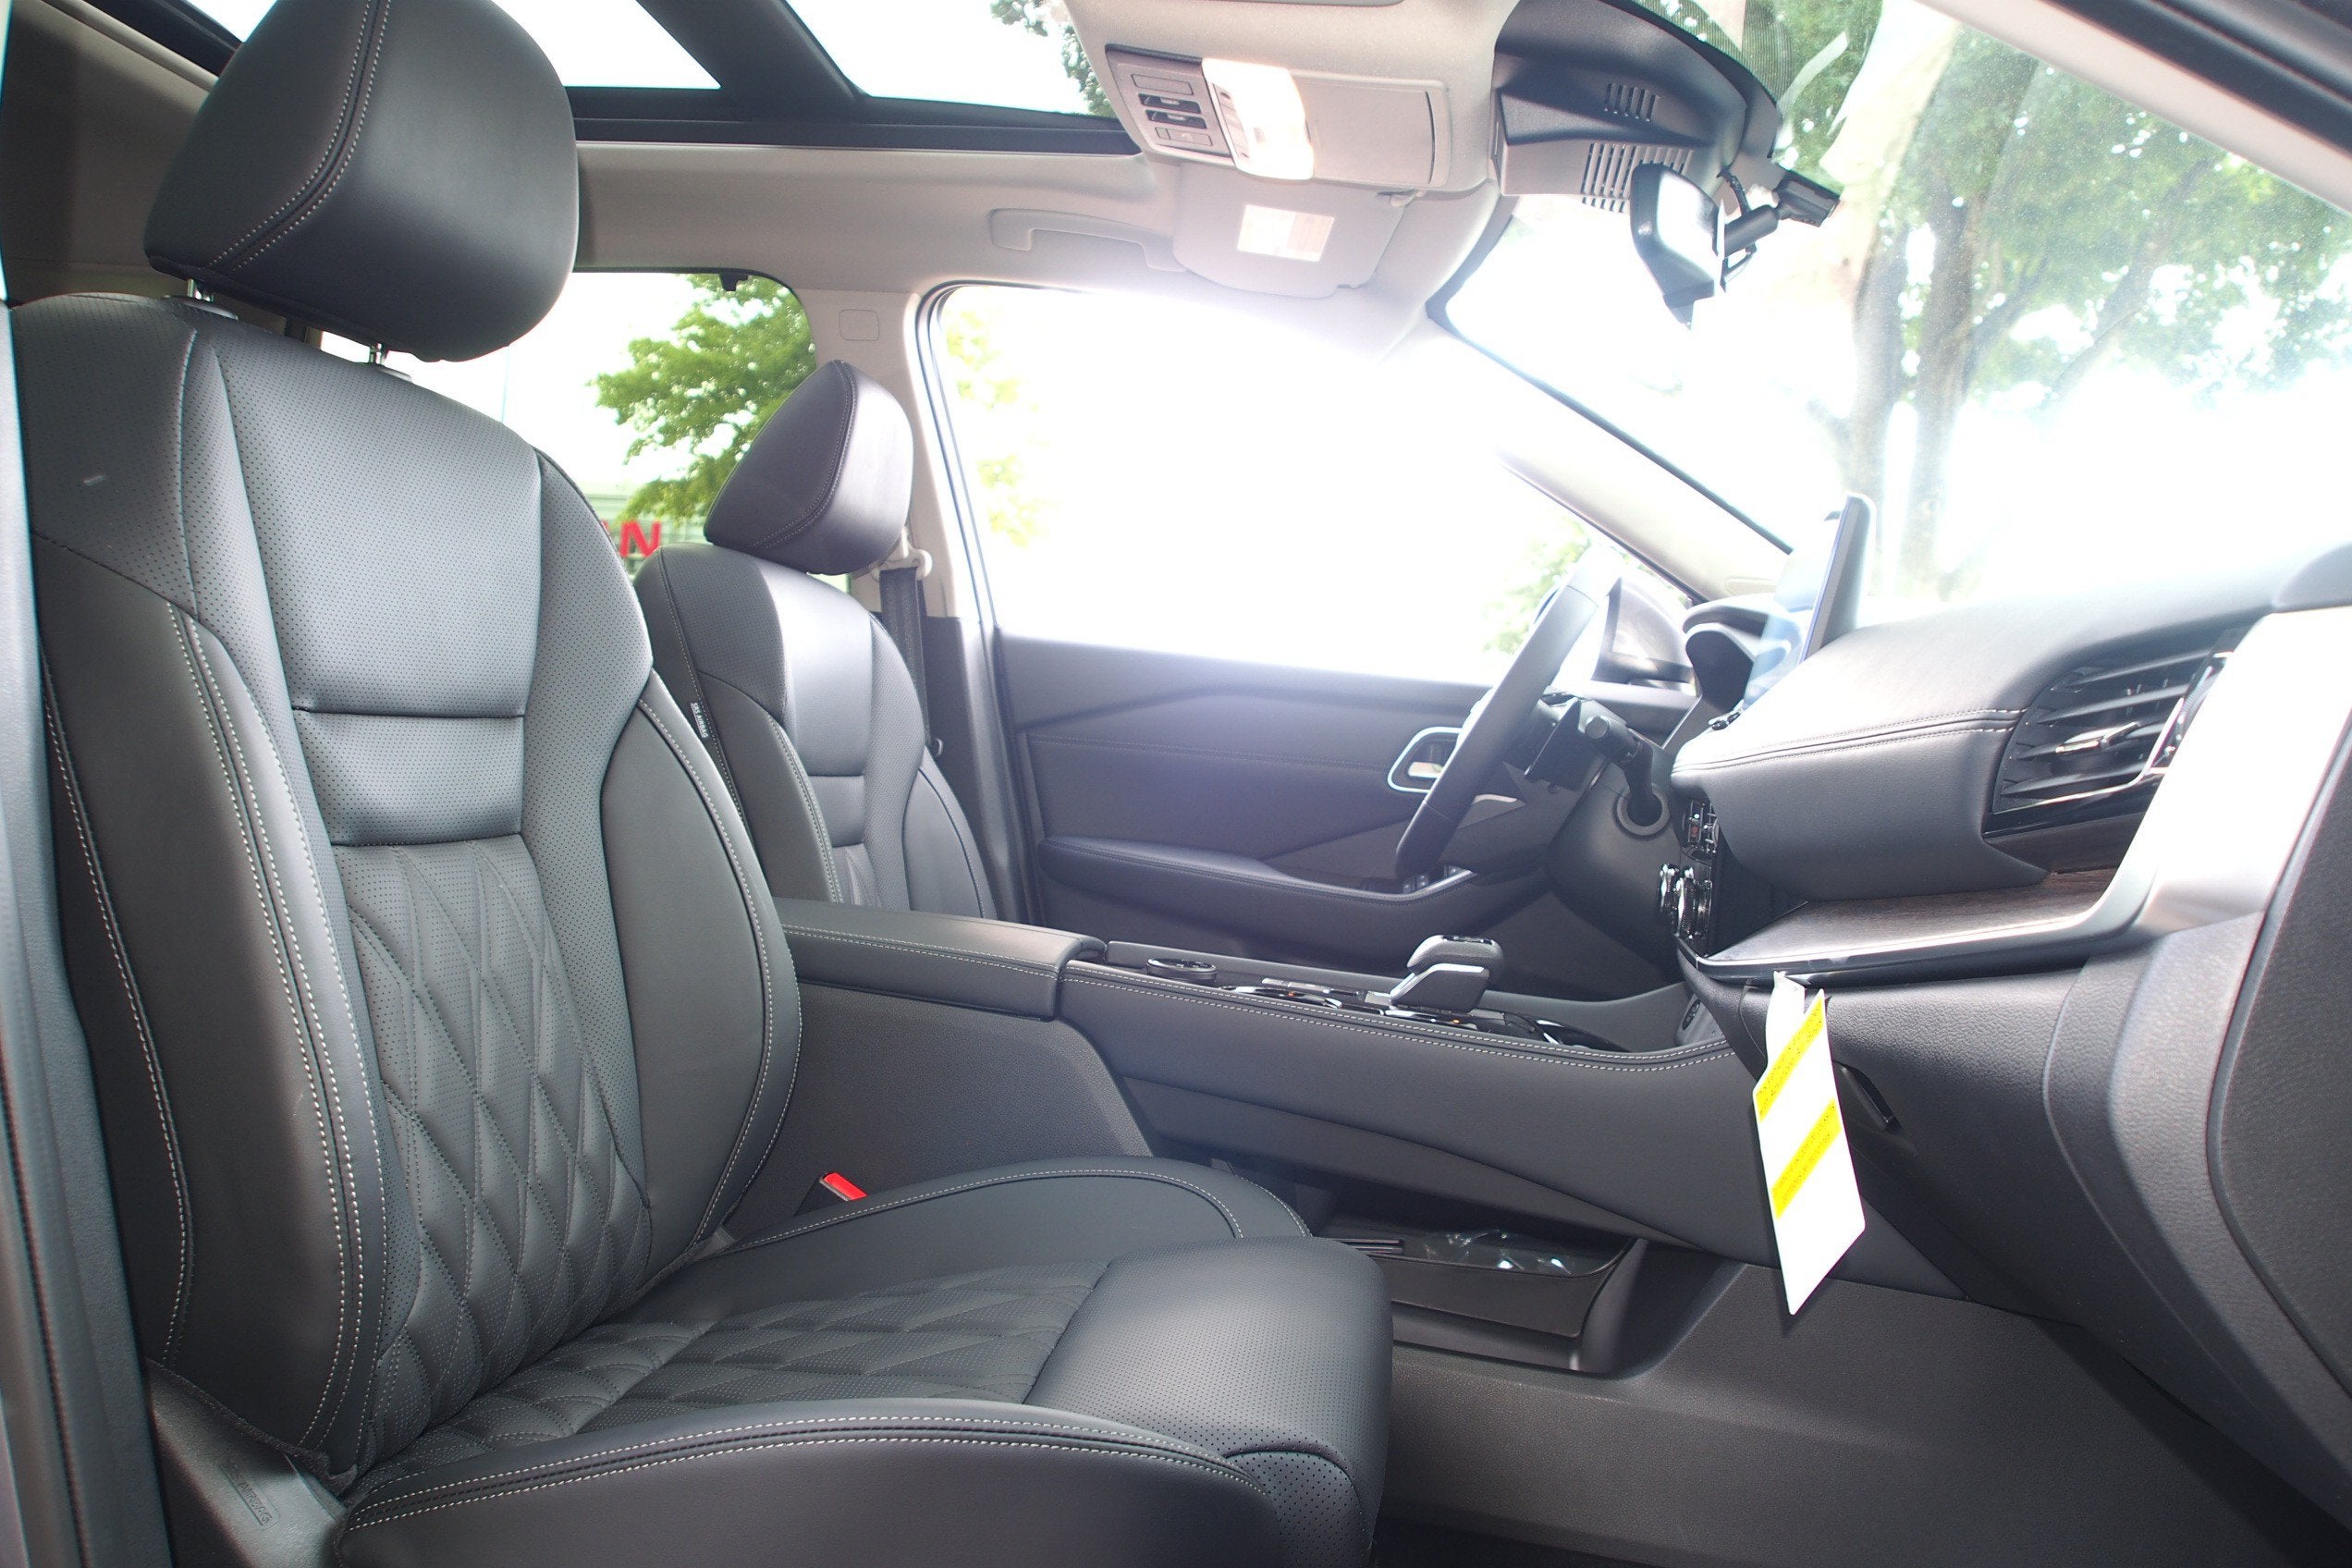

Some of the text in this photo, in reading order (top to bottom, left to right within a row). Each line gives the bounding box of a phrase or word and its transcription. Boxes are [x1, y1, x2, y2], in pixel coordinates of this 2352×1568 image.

[602, 519, 662, 557] N
[692, 703, 709, 738] SRS AIRBAG
[237, 1481, 272, 1523] AIRBAG
